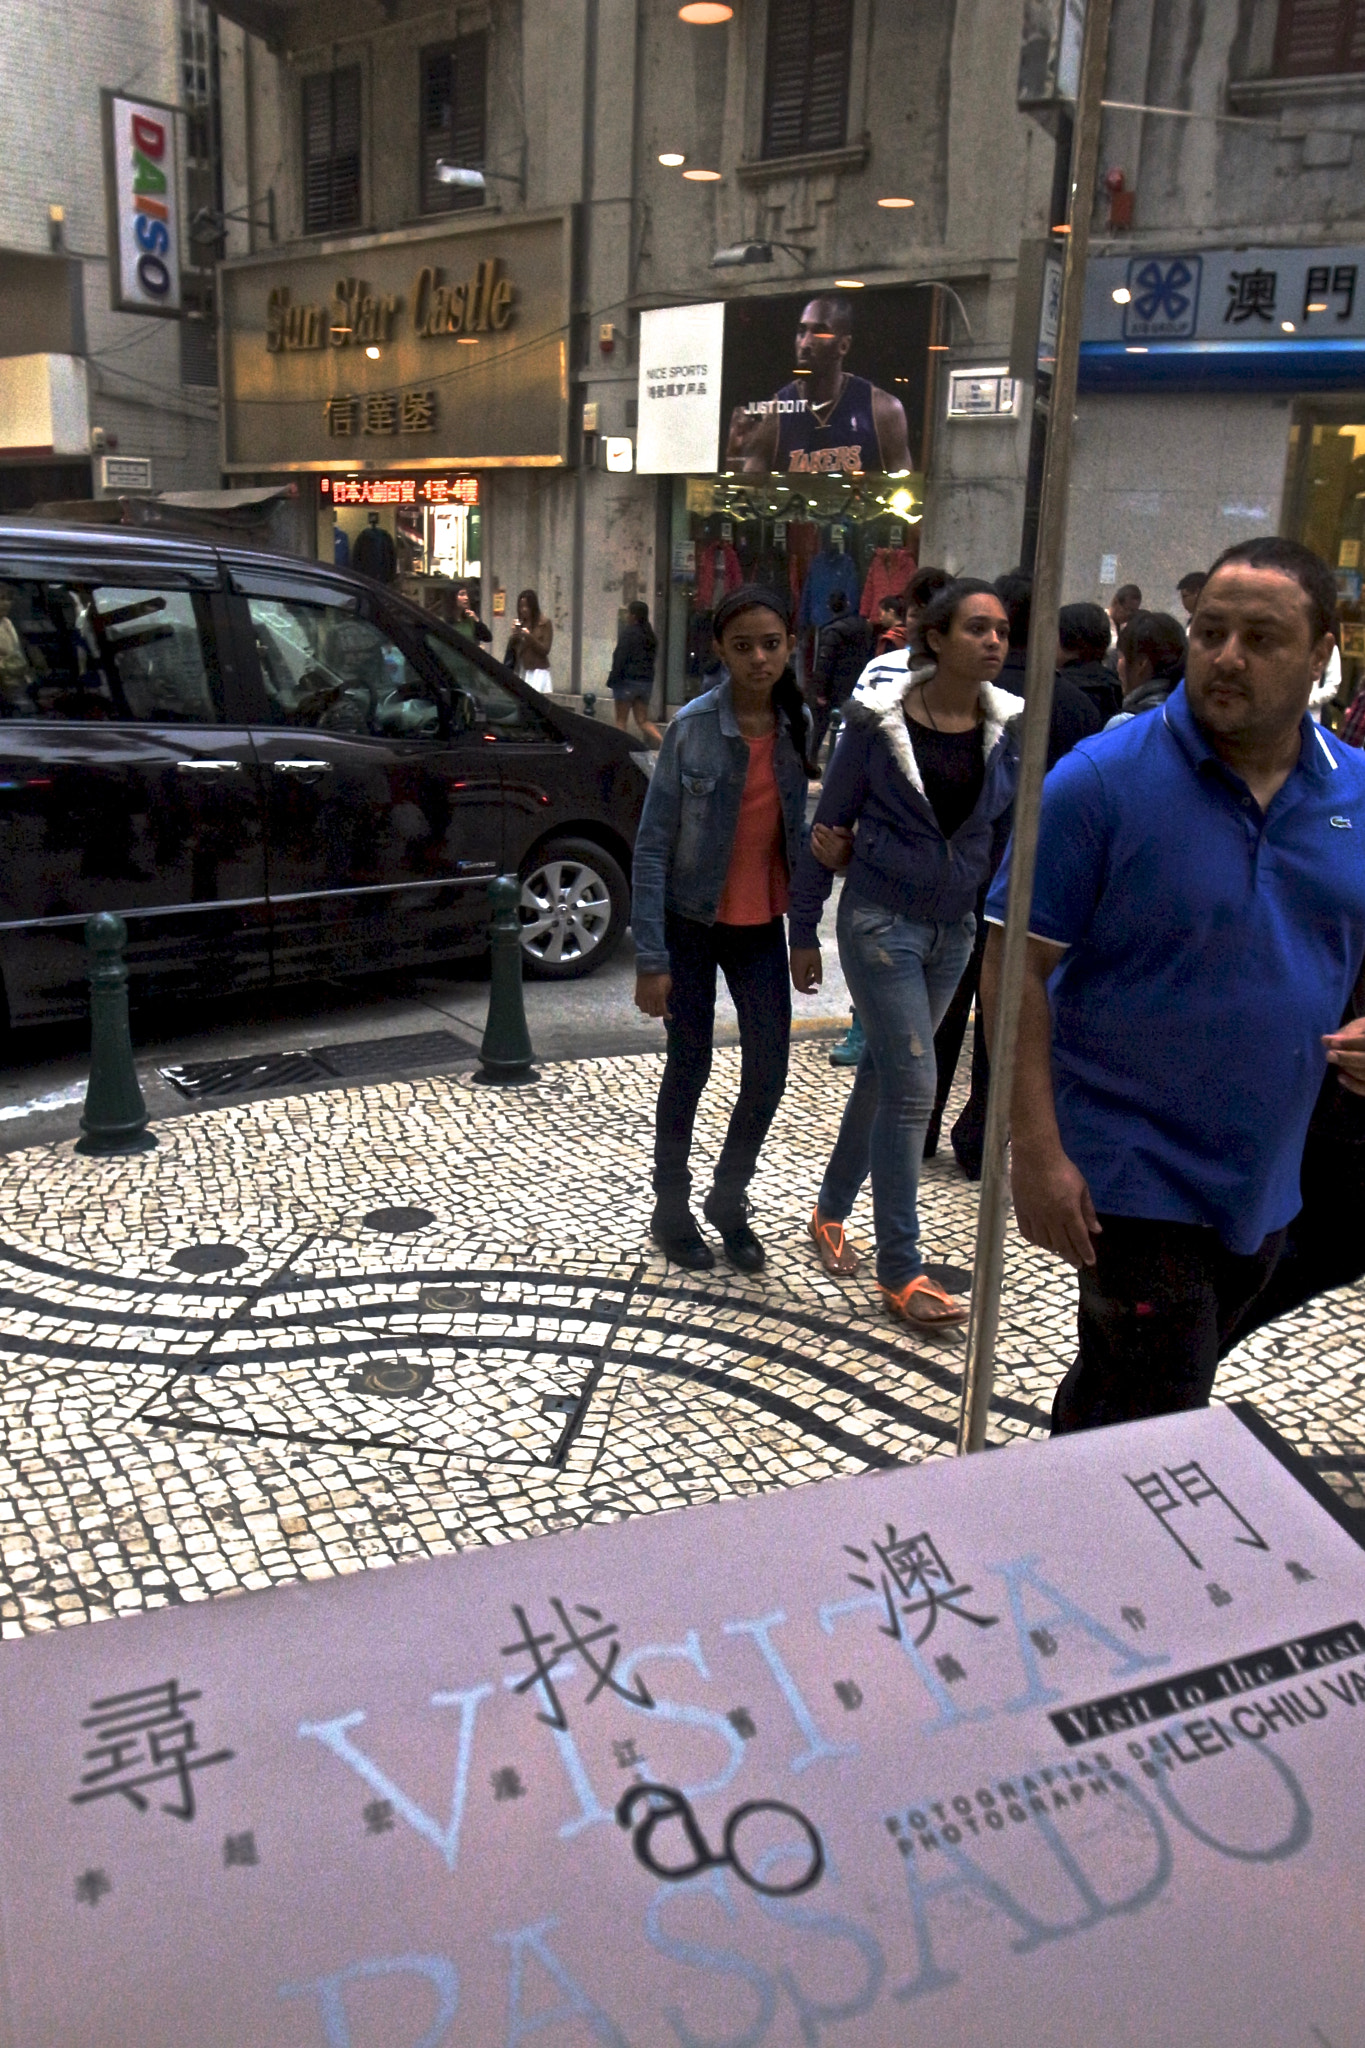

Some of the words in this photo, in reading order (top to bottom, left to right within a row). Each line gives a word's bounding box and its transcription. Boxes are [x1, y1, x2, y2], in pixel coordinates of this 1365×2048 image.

[131, 113, 171, 297] DAISO
[267, 286, 326, 352] Sun
[331, 277, 400, 347] Star
[413, 258, 514, 337] Castle
[1223, 264, 1359, 325] 澳門
[646, 366, 668, 380] NICE
[669, 364, 708, 378] SPORTS
[744, 401, 774, 415] JUST
[778, 400, 793, 414] DO
[795, 399, 809, 413] IT
[788, 445, 863, 473] LAKERS
[297, 1553, 1172, 1872] VISITA
[1066, 1694, 1152, 1741] Visit
[1166, 1685, 1206, 1714] to
[1217, 1661, 1275, 1697] the
[1283, 1631, 1363, 1673] Past
[1161, 1715, 1235, 1765] LEI
[1230, 1686, 1329, 1741] CHIU
[615, 1783, 825, 1898] ao
